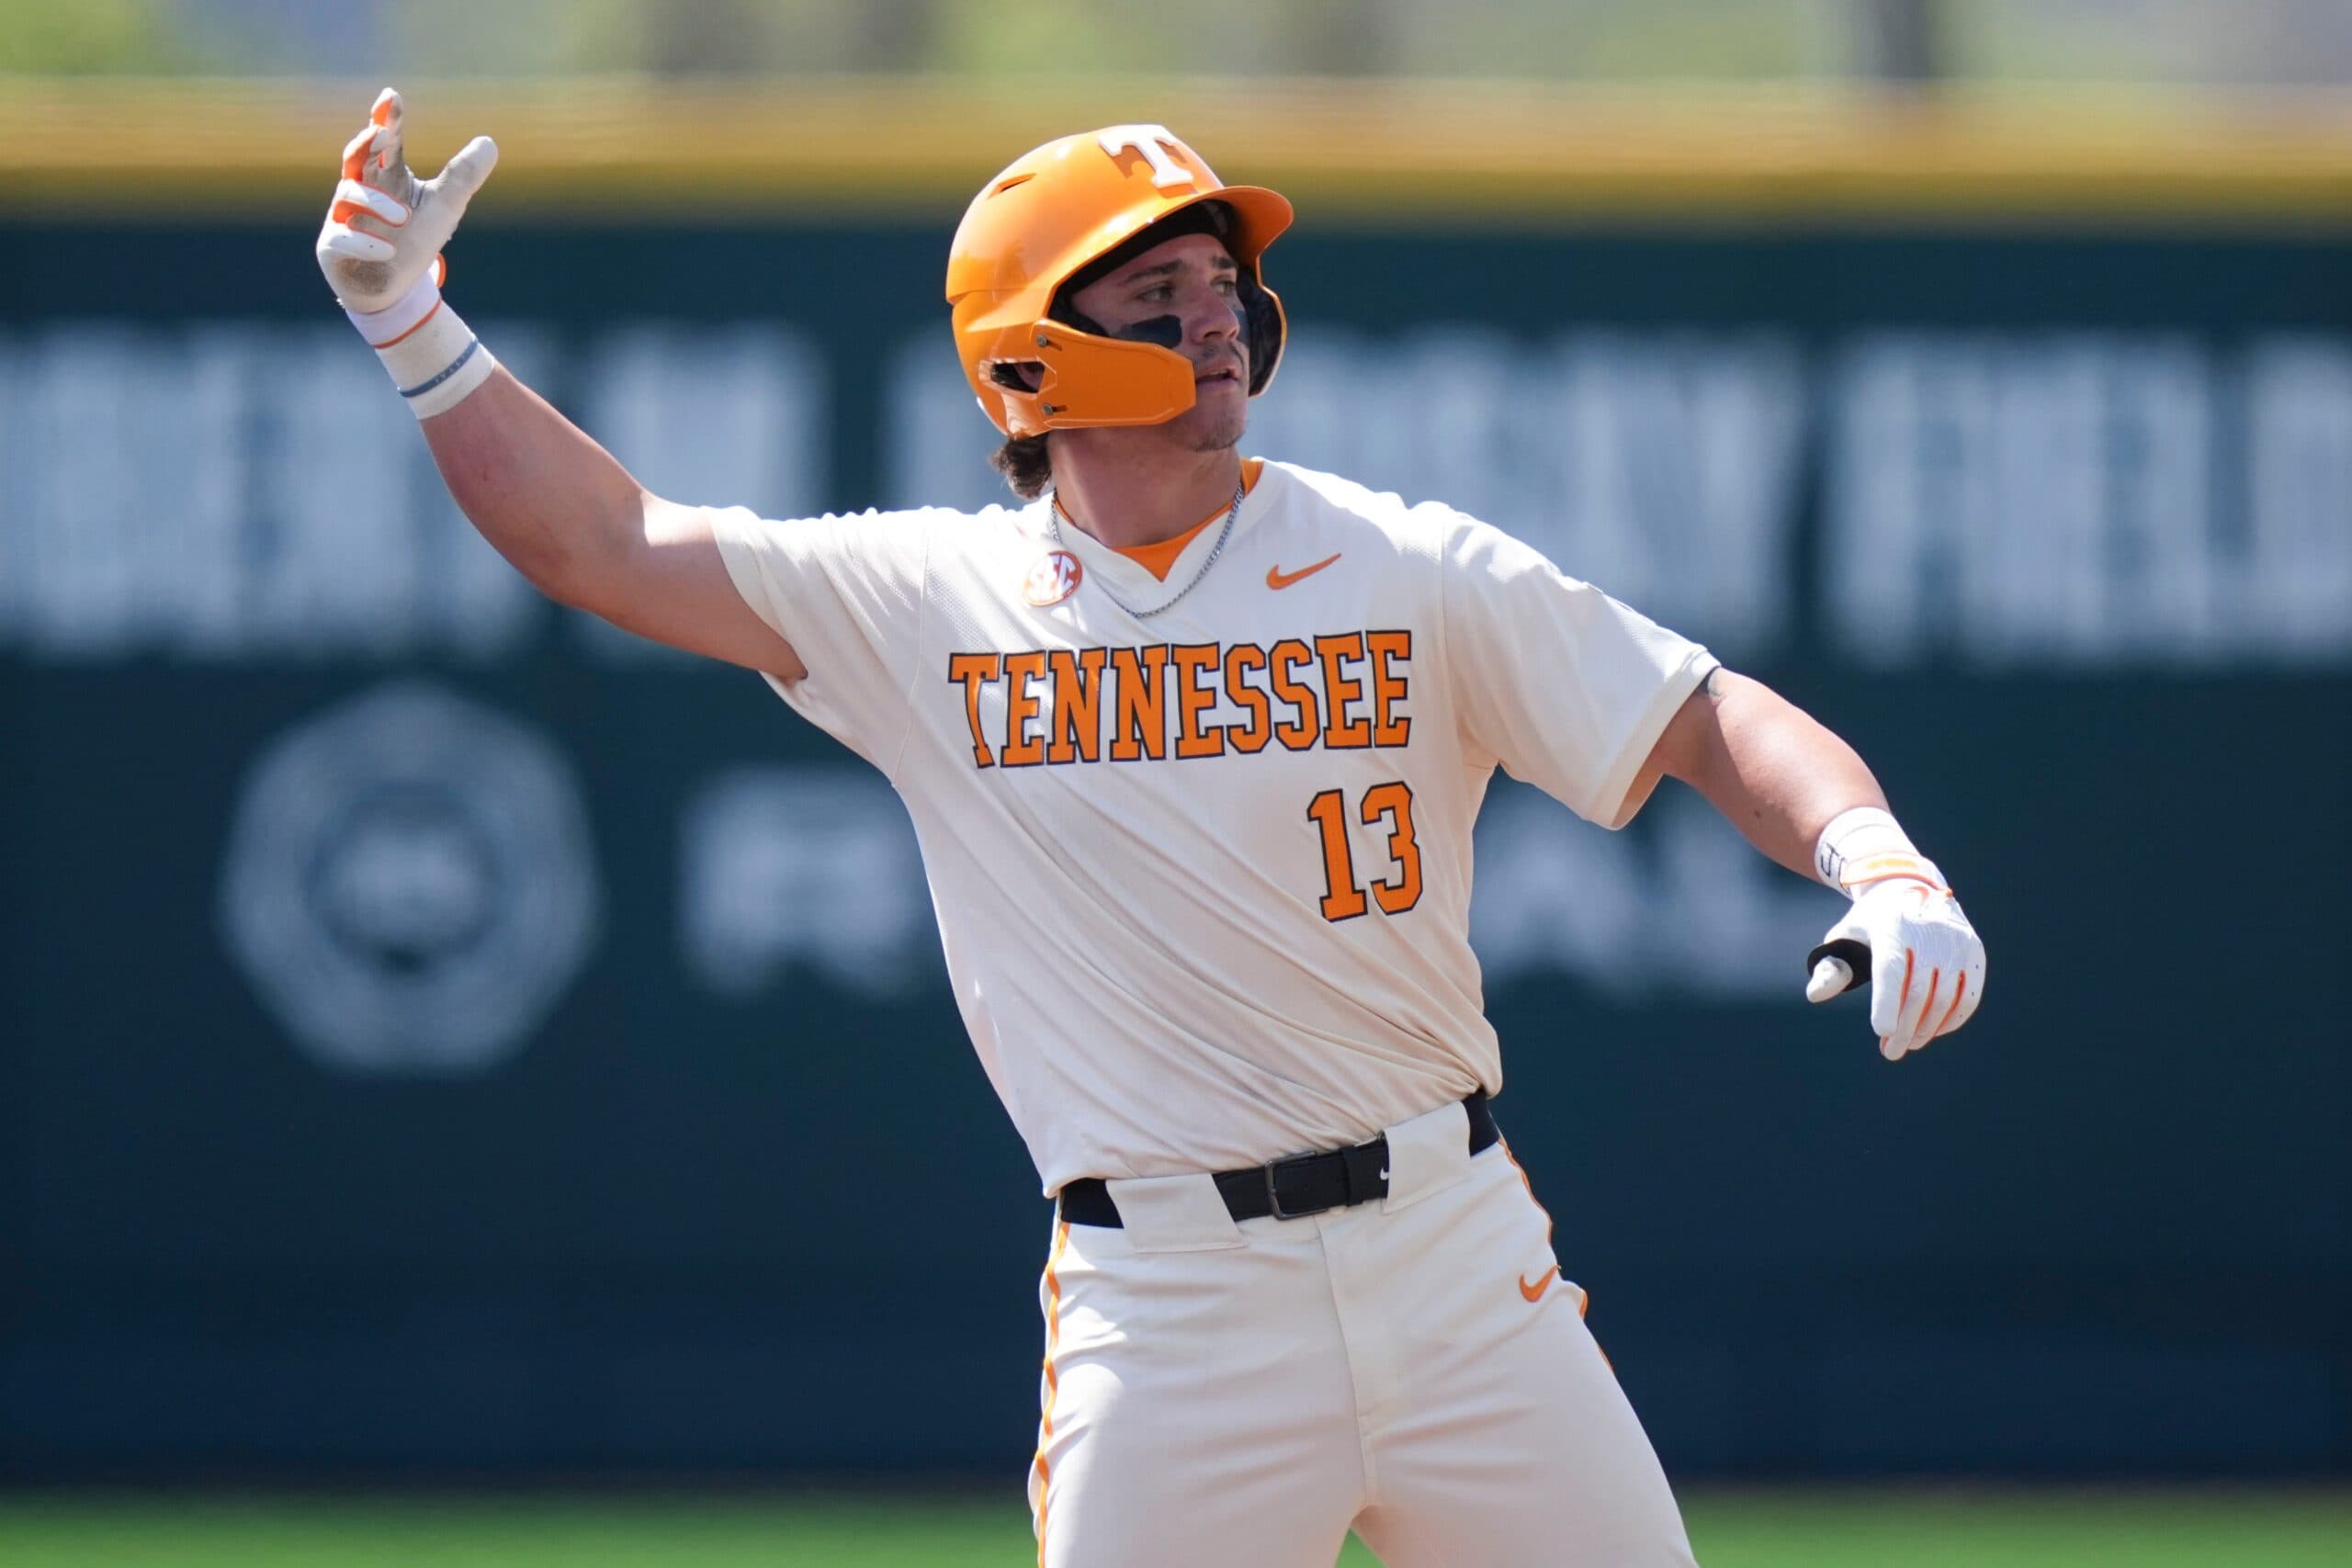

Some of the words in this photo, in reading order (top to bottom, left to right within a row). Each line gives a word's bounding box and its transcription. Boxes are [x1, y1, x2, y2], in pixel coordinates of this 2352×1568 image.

[1098, 124, 1194, 189] T
[947, 630, 1412, 768] TENNESSEE
[1307, 781, 1423, 922] 13
